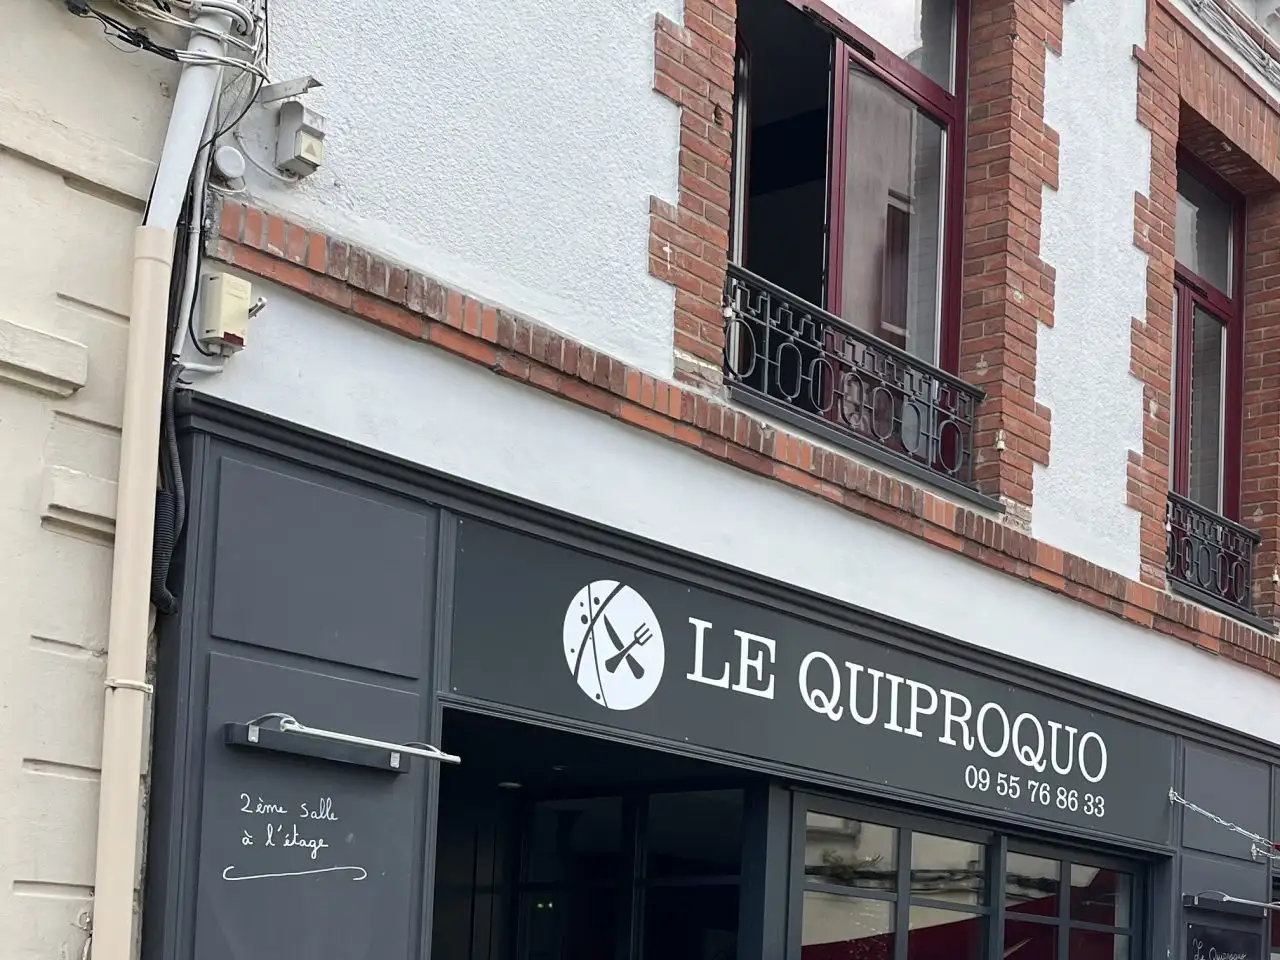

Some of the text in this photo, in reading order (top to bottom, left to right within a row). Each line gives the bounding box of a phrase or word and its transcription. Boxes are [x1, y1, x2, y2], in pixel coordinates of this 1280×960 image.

[686, 617, 1108, 783] LE QUIPROQUO
[240, 793, 288, 814] 2ème
[965, 764, 1105, 818] 09 55 76 86 33
[242, 824, 329, 860] à l'étage
